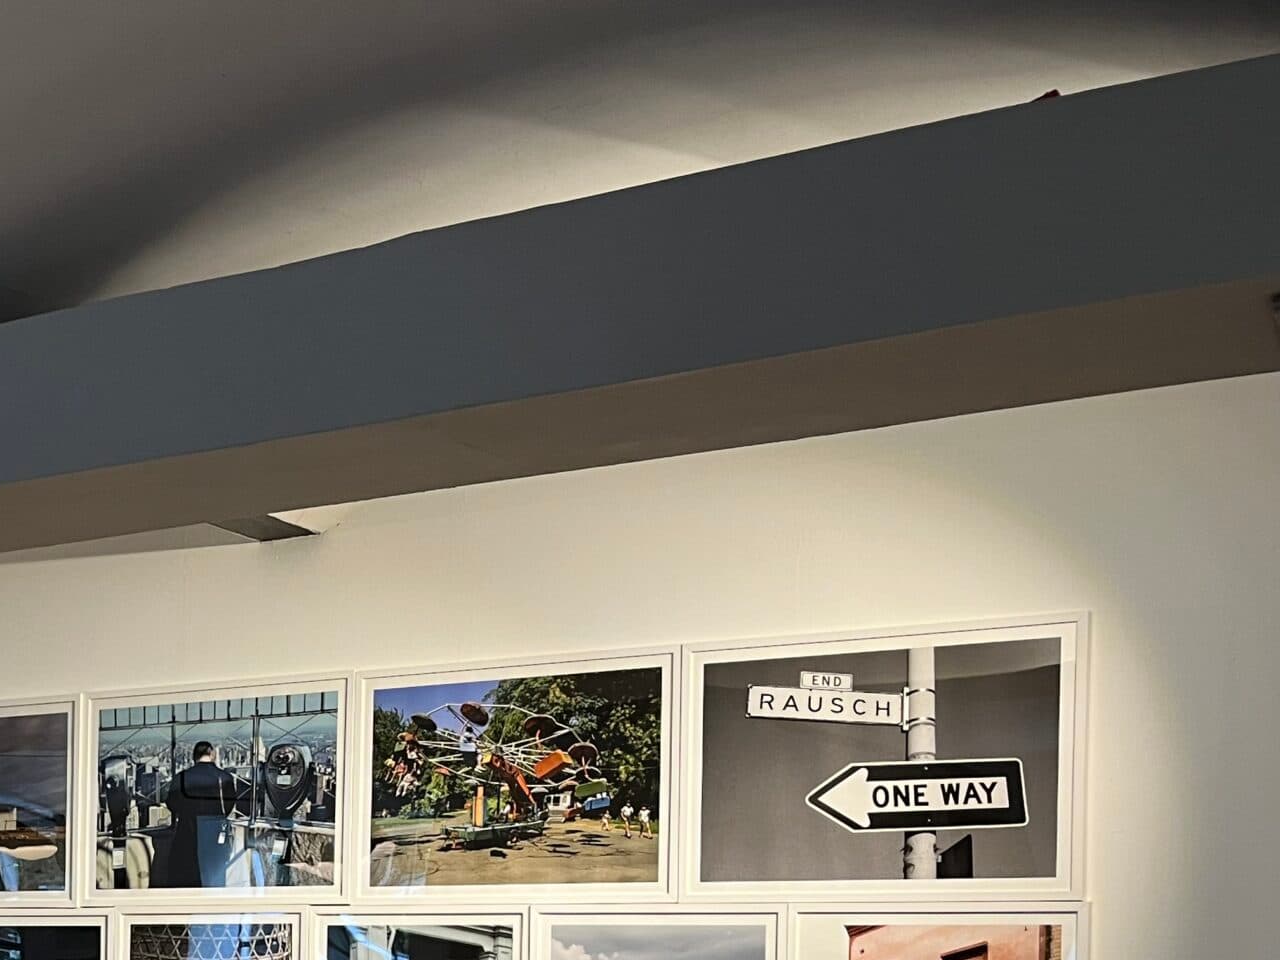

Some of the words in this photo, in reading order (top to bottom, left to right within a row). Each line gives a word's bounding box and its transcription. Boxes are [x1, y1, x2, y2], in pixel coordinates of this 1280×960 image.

[811, 674, 842, 687] END
[759, 693, 891, 717] RAUSCH
[872, 784, 929, 808] ONE
[940, 782, 998, 806] WAY
